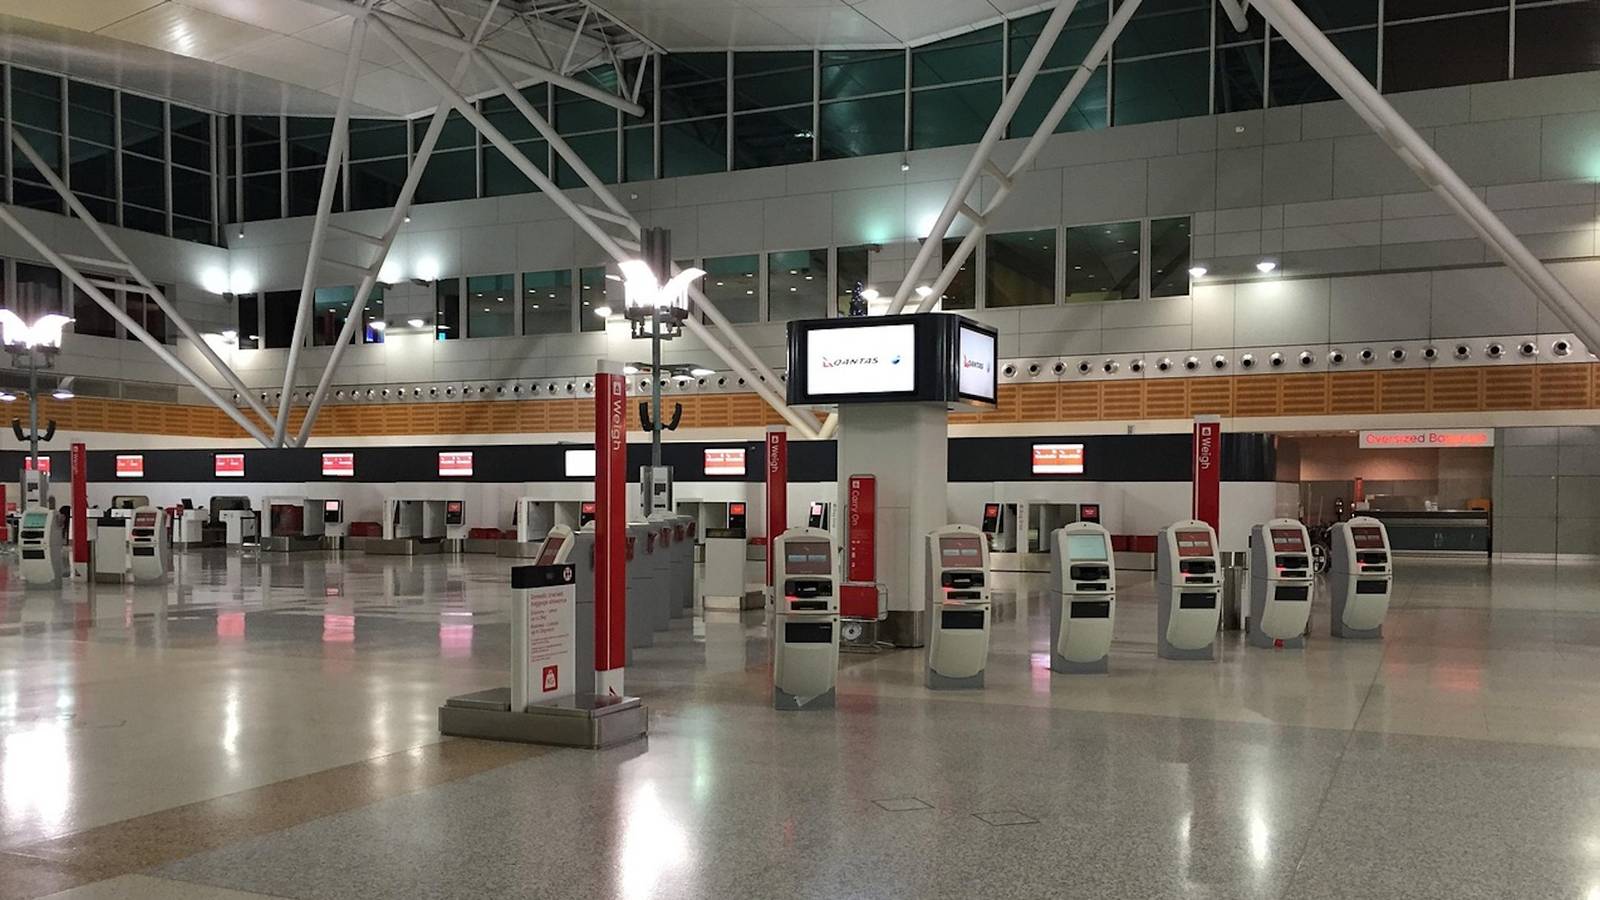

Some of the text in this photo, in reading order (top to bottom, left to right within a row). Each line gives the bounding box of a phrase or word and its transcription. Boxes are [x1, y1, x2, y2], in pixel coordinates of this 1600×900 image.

[833, 357, 879, 366] QANTAS
[612, 400, 622, 450] Weigh
[770, 444, 780, 473] Weigh
[1199, 437, 1211, 470] Weigh
[851, 490, 860, 513] Carry
[851, 513, 860, 526] On
